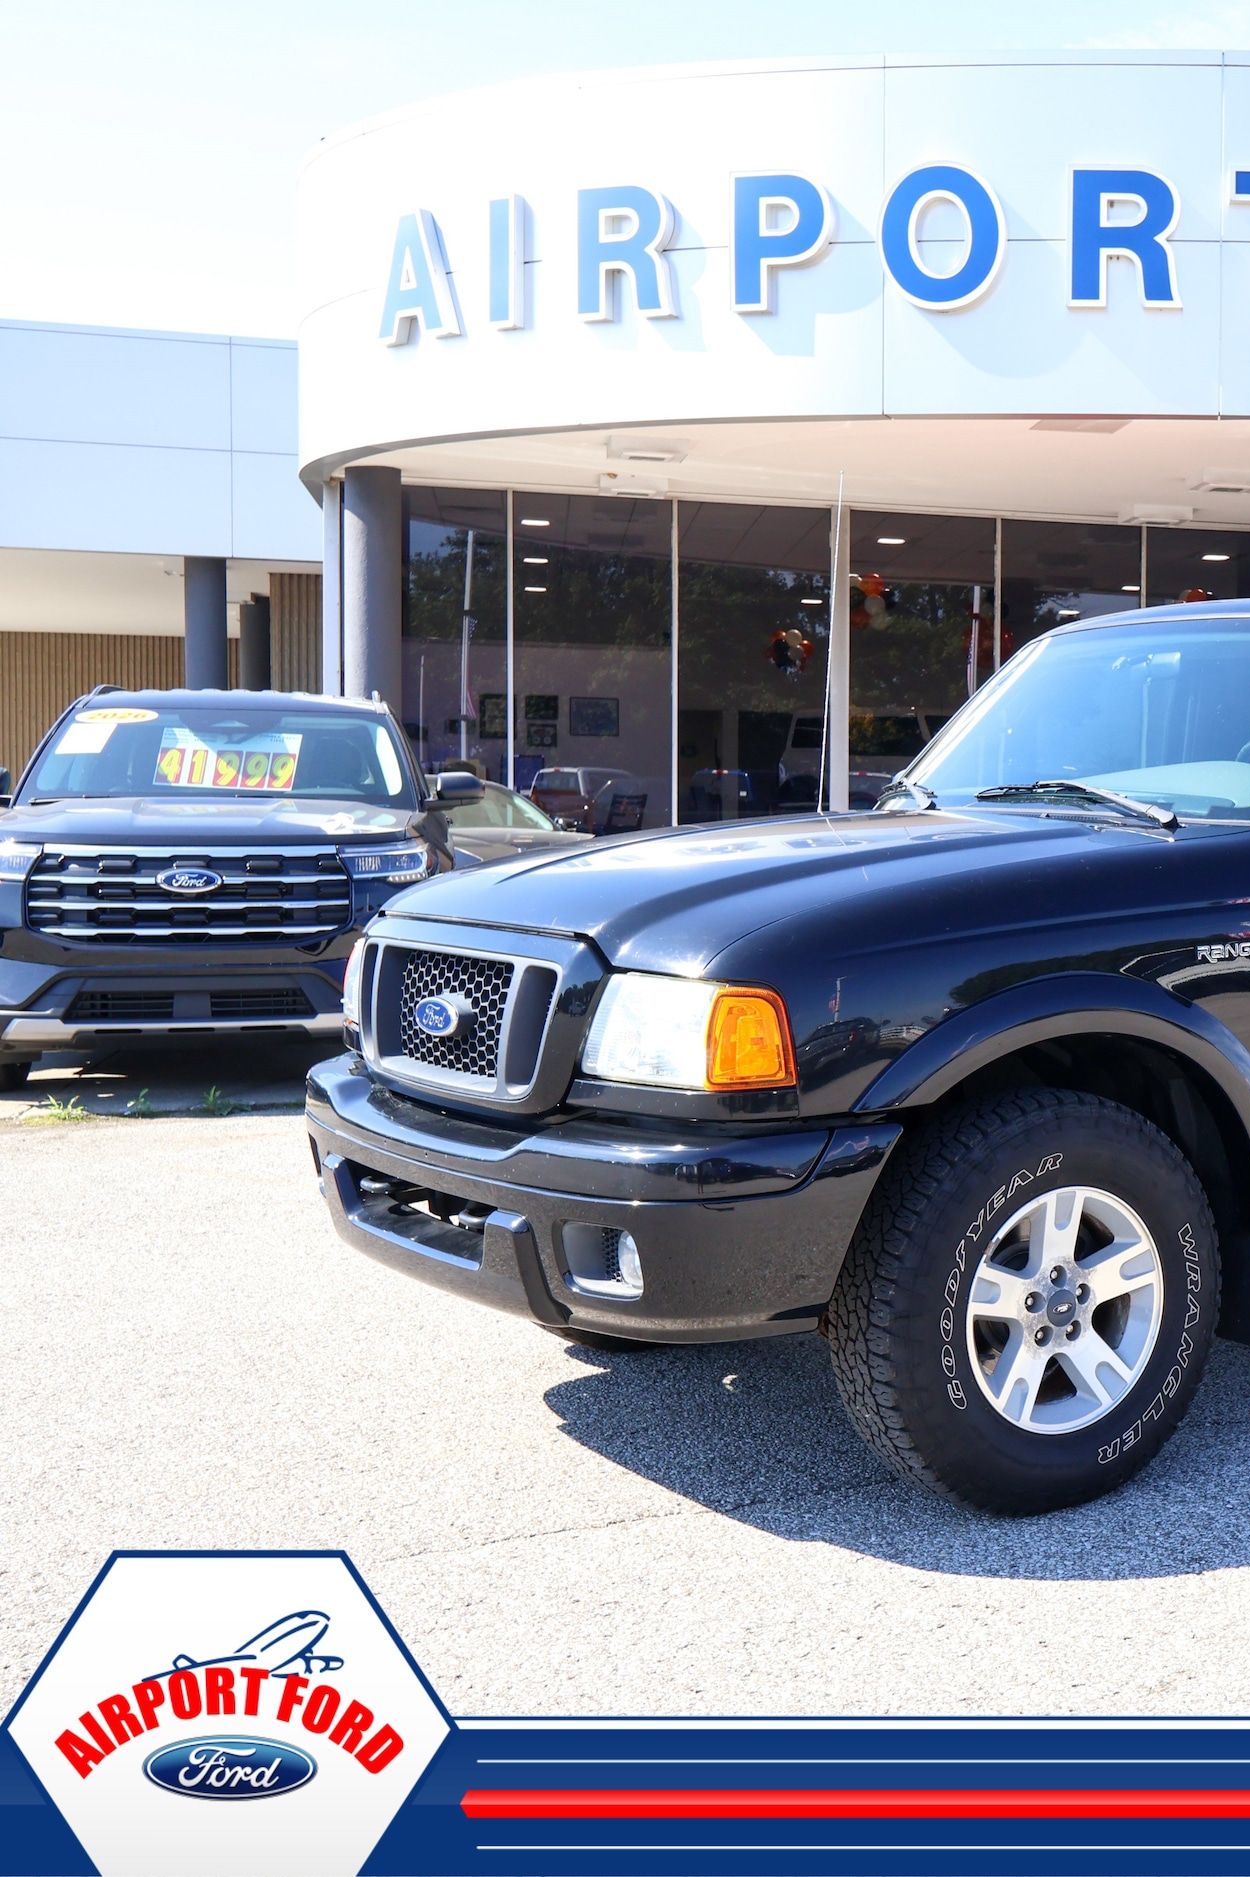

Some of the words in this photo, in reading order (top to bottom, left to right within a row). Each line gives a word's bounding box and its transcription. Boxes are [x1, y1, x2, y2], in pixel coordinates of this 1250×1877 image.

[172, 873, 207, 887] Ford
[940, 1152, 1063, 1410] GOODYEAR
[1098, 1223, 1201, 1465] WRANGLER
